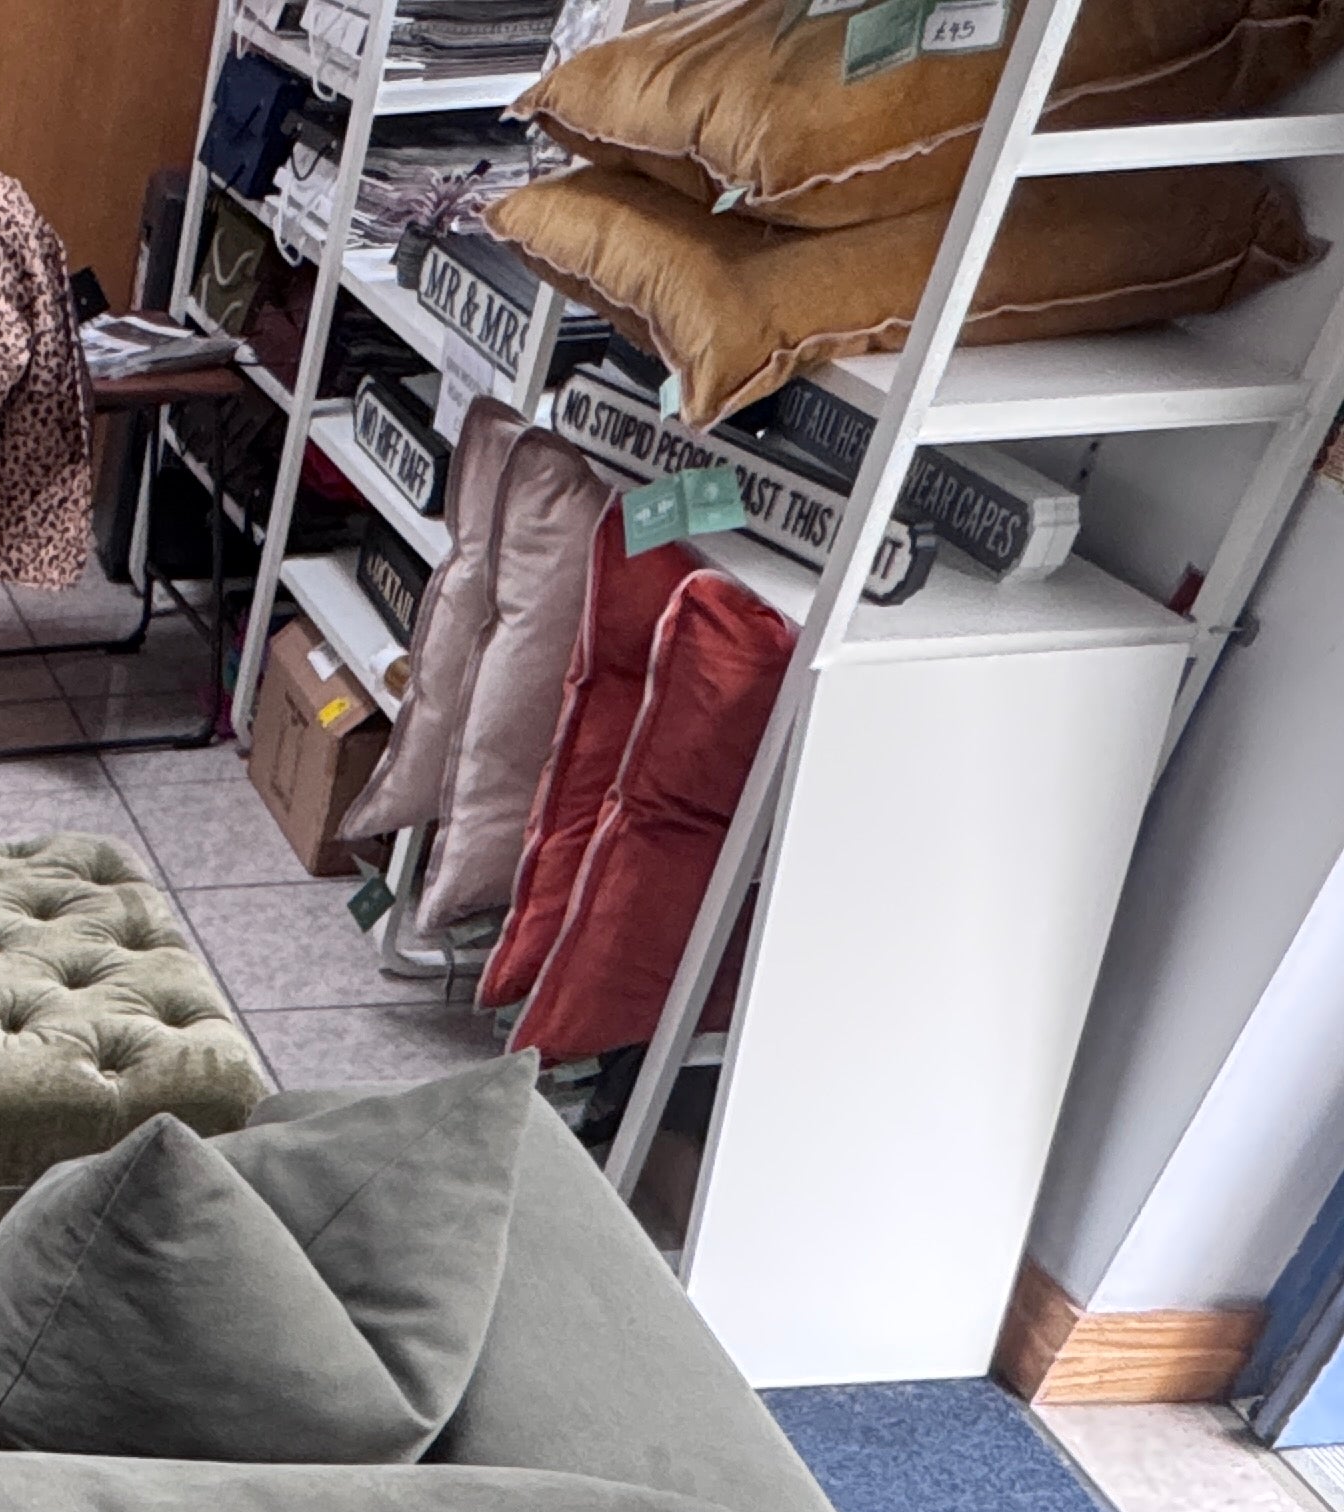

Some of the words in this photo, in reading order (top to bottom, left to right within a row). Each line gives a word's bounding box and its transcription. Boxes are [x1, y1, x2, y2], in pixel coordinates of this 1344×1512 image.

[425, 252, 461, 320] MR
[460, 279, 480, 335] &
[360, 398, 378, 446] NO
[563, 388, 592, 431] NO
[589, 400, 656, 461] STUPID
[781, 490, 834, 548] THIS
[805, 398, 838, 447] ALL
[953, 487, 1022, 558] CAPES
